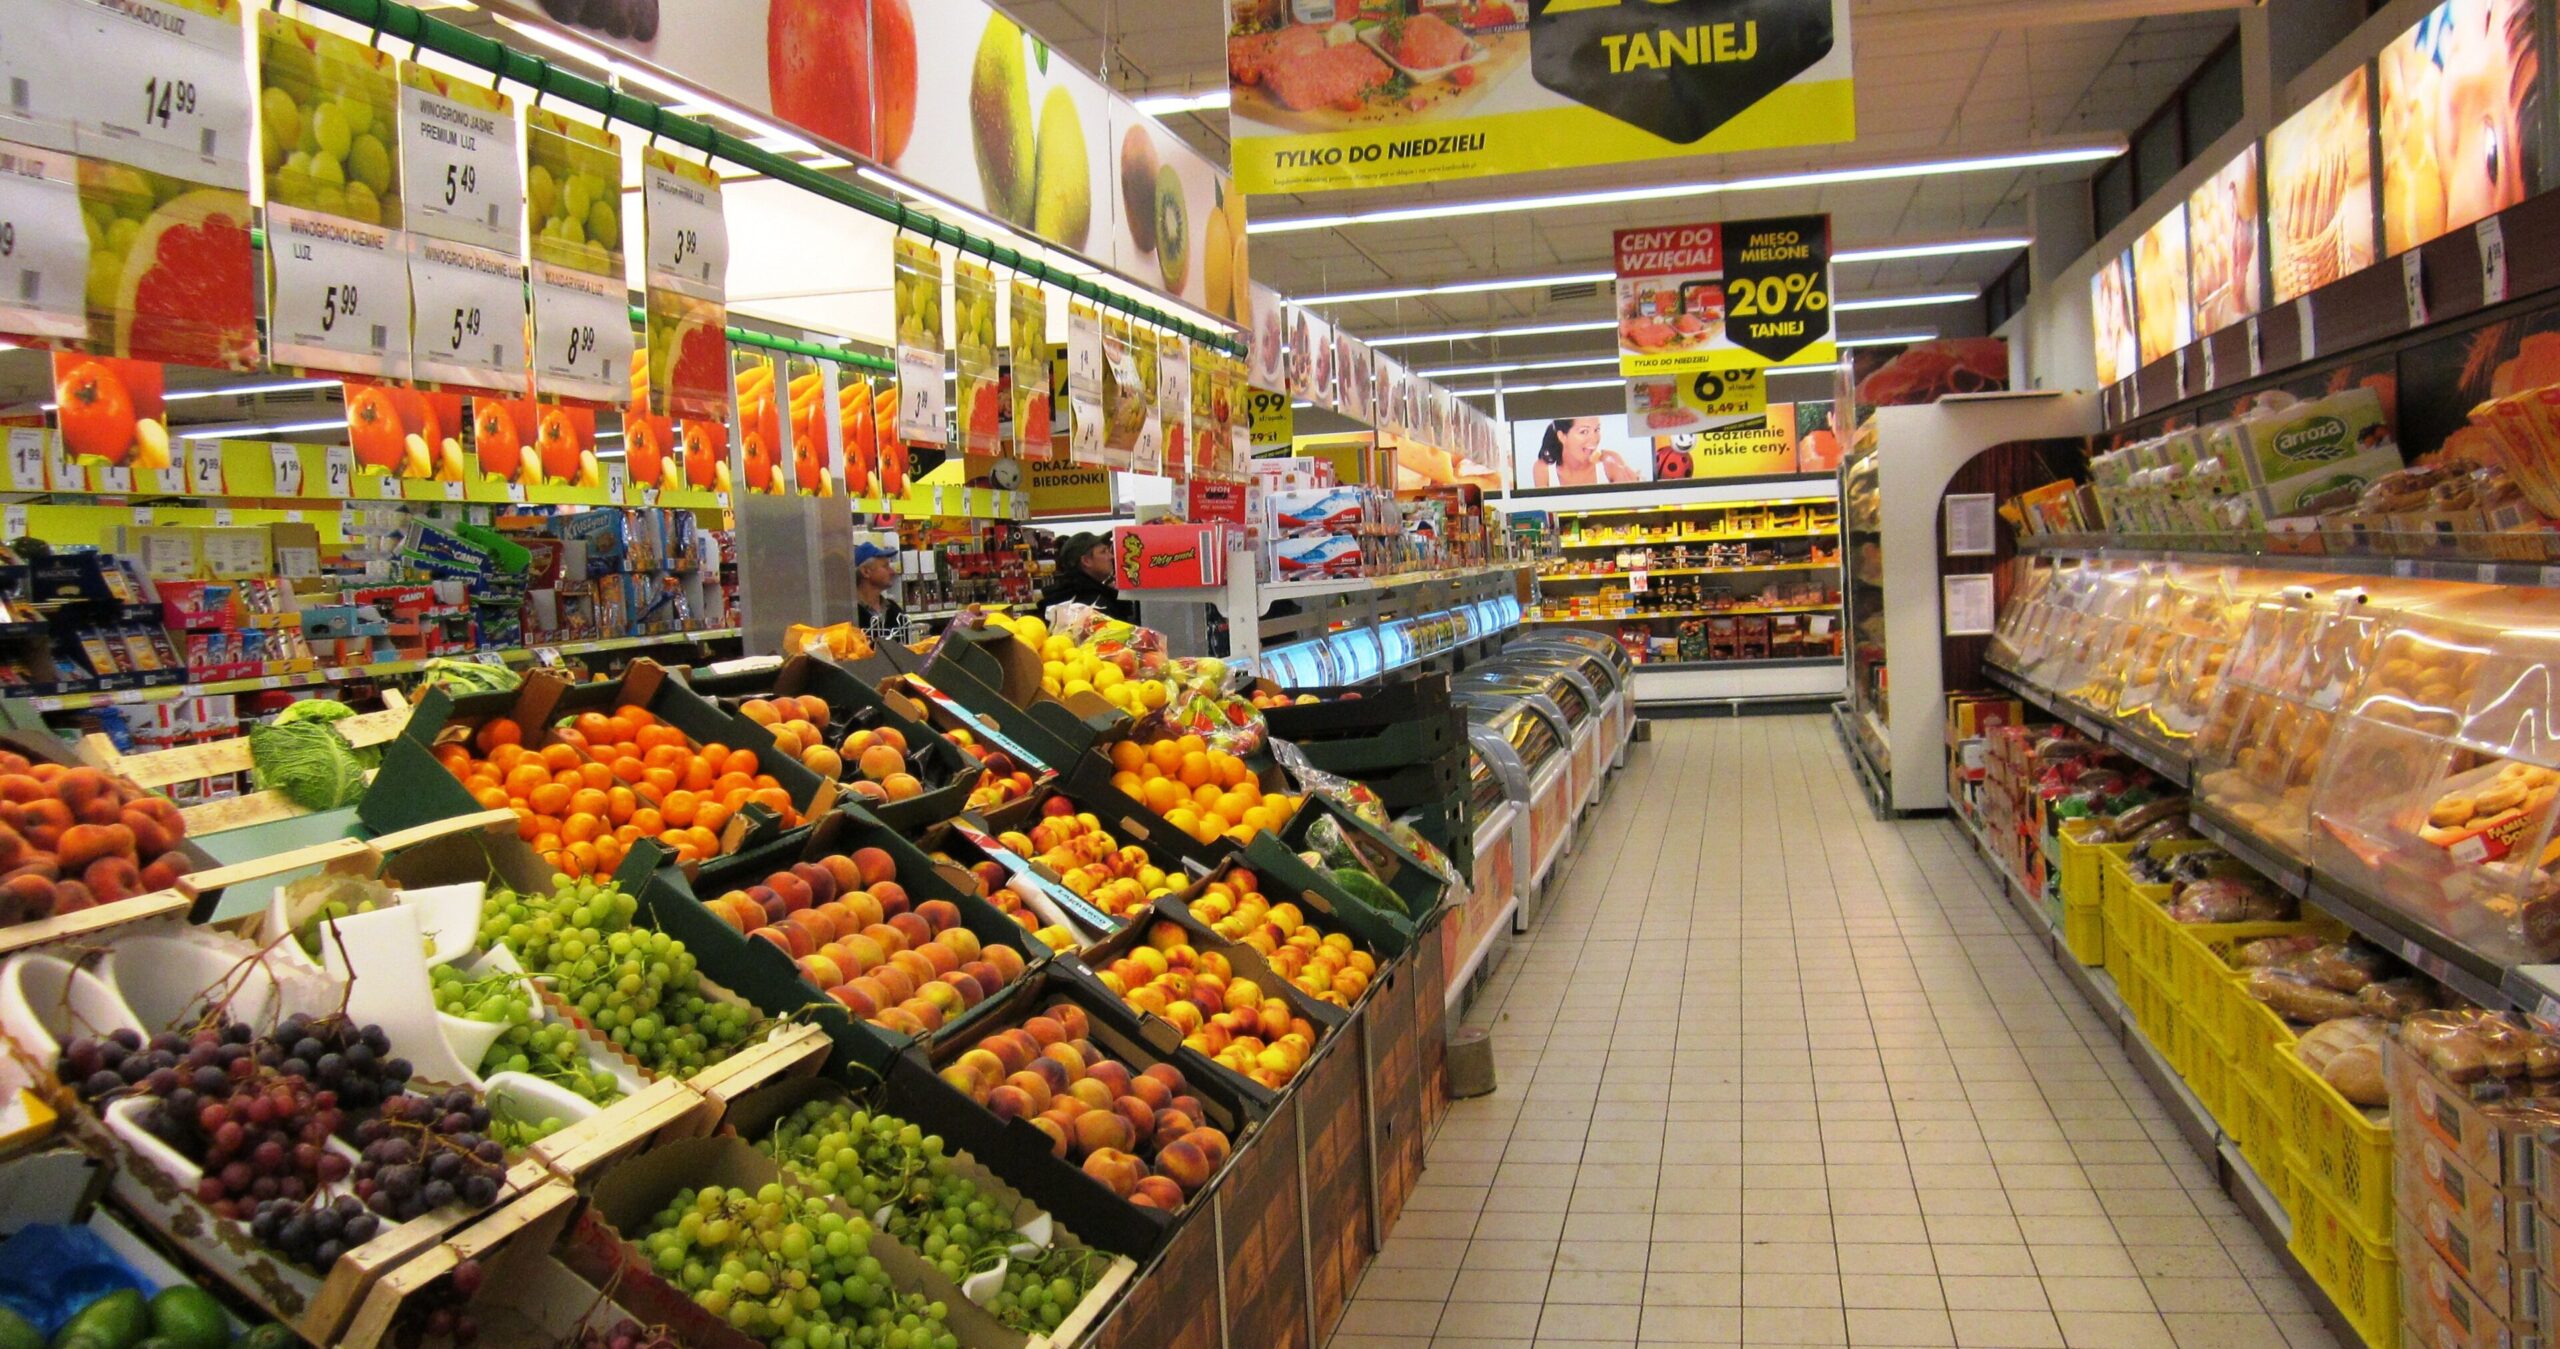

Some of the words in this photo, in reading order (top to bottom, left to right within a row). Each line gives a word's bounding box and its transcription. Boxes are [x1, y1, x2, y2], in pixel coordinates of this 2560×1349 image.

[163, 13, 185, 36] LUZ
[1601, 20, 1757, 73] TANIEJ
[420, 100, 469, 128] WINOGRONO
[470, 115, 495, 136] JASNE
[421, 122, 458, 147] PREMIUM
[461, 134, 477, 152] LUZ
[1274, 147, 1342, 168] TYLKO
[1349, 143, 1382, 164] DO
[1388, 132, 1486, 160] NIEDZIELI
[694, 191, 705, 205] LUZ
[290, 216, 350, 244] WINOGRONO
[351, 228, 384, 251] CIEMNE
[1621, 229, 1675, 252] CENY
[1680, 228, 1713, 246] DO
[1750, 231, 1799, 250] MIĘSO
[293, 242, 313, 261] LUZ
[424, 245, 475, 270] WINOGRONO
[1622, 247, 1714, 272] WZIĘCIA!
[1740, 245, 1810, 264] MIELONE
[1728, 271, 1828, 317] 20%
[1749, 321, 1804, 339] TANIEJ
[1634, 359, 1659, 368] TYLKO
[1660, 358, 1673, 366] DO
[1674, 355, 1710, 365] NIEDZIELI
[1694, 371, 1724, 402] 6
[1255, 393, 1285, 413] 99
[1703, 424, 1785, 442] Codziennie
[2280, 420, 2341, 449] arroza
[1703, 442, 1748, 456] niskie
[1752, 443, 1791, 456] ceny.
[1032, 459, 1083, 472] OKAZ
[1033, 472, 1105, 487] BIEDRONKI
[2486, 814, 2528, 840] FAMILY
